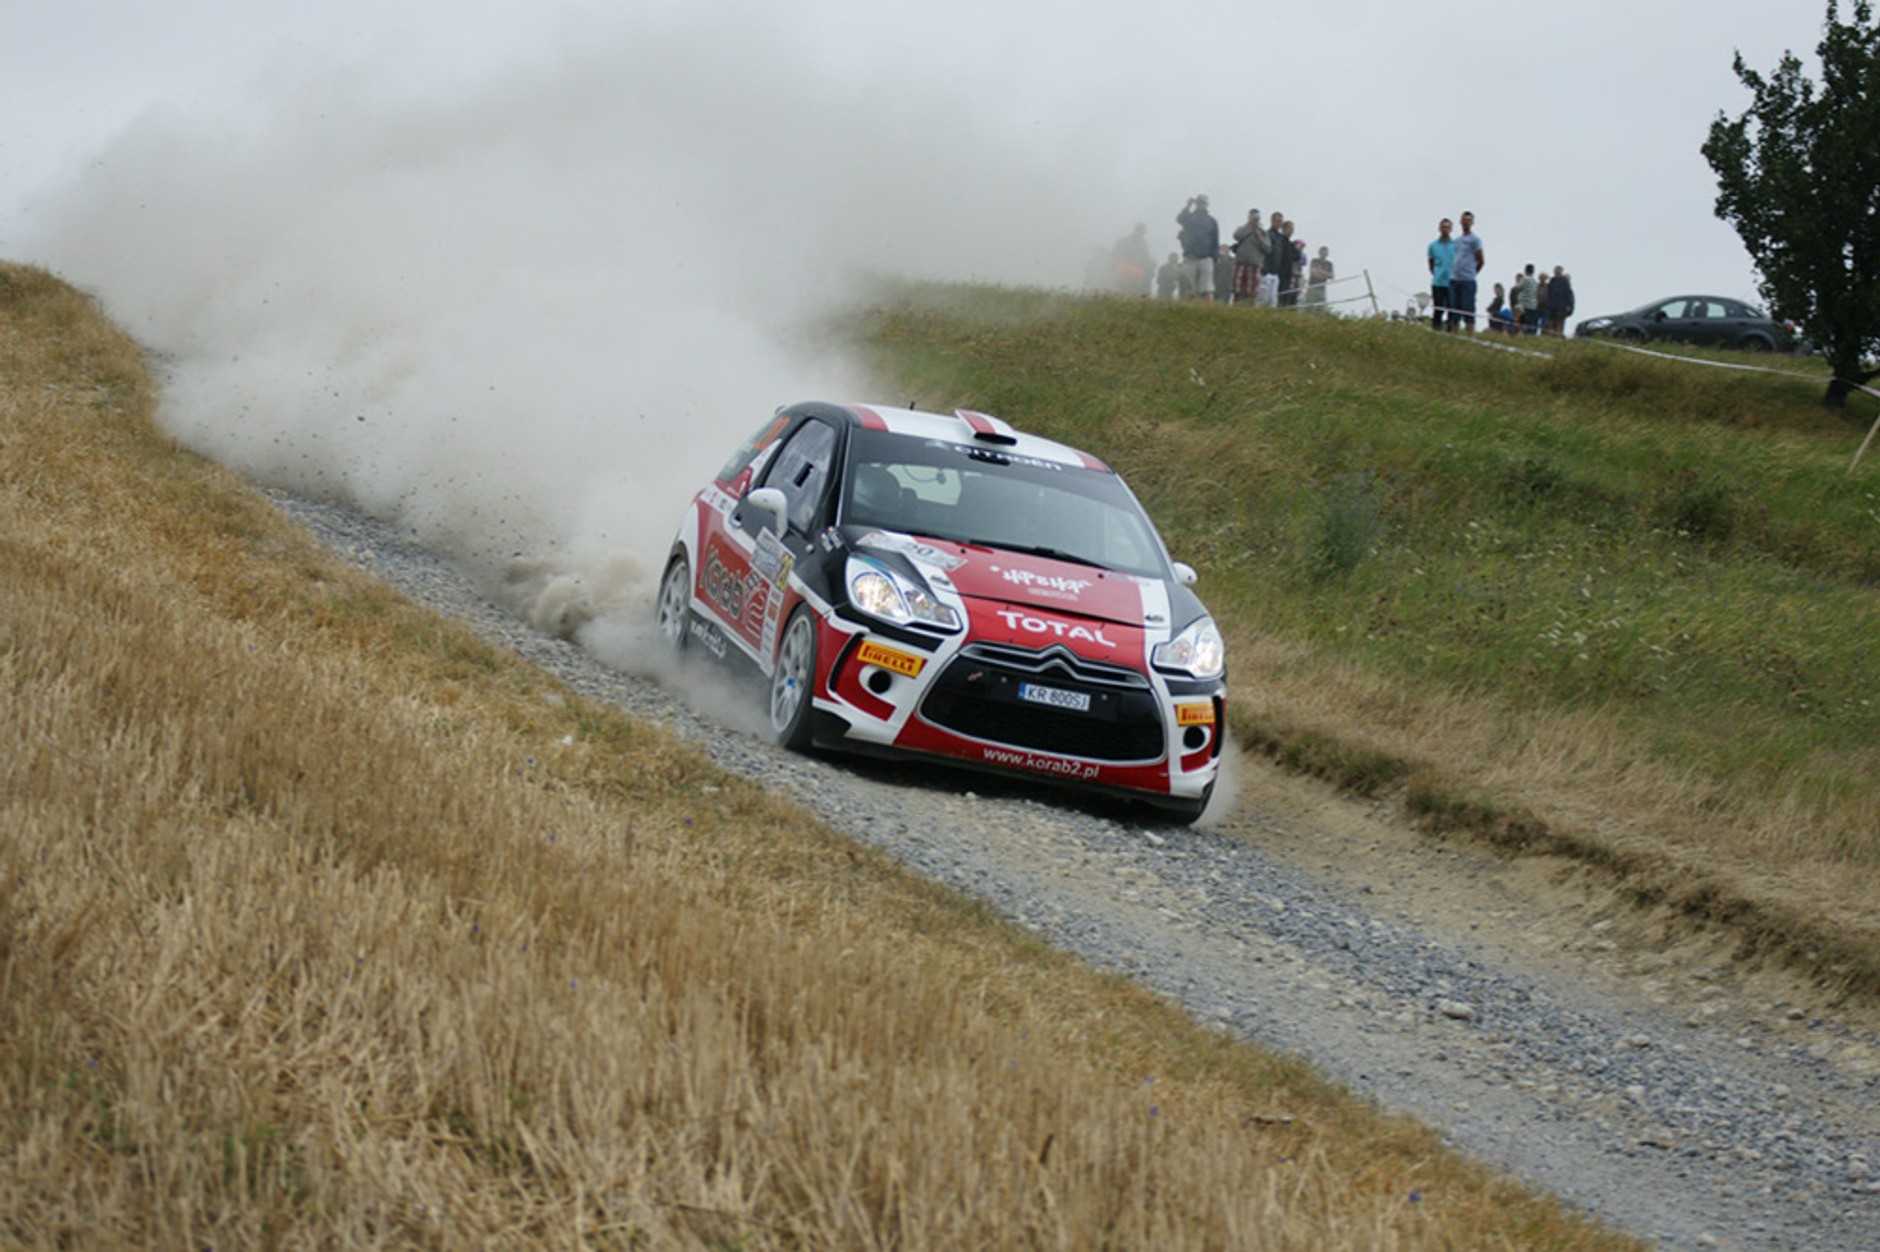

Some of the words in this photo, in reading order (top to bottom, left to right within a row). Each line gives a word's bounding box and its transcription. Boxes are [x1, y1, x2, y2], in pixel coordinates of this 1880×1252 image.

[997, 610, 1117, 648] TOTAL
[1028, 686, 1048, 700] KR
[982, 747, 1101, 779] www.korab2.pl
